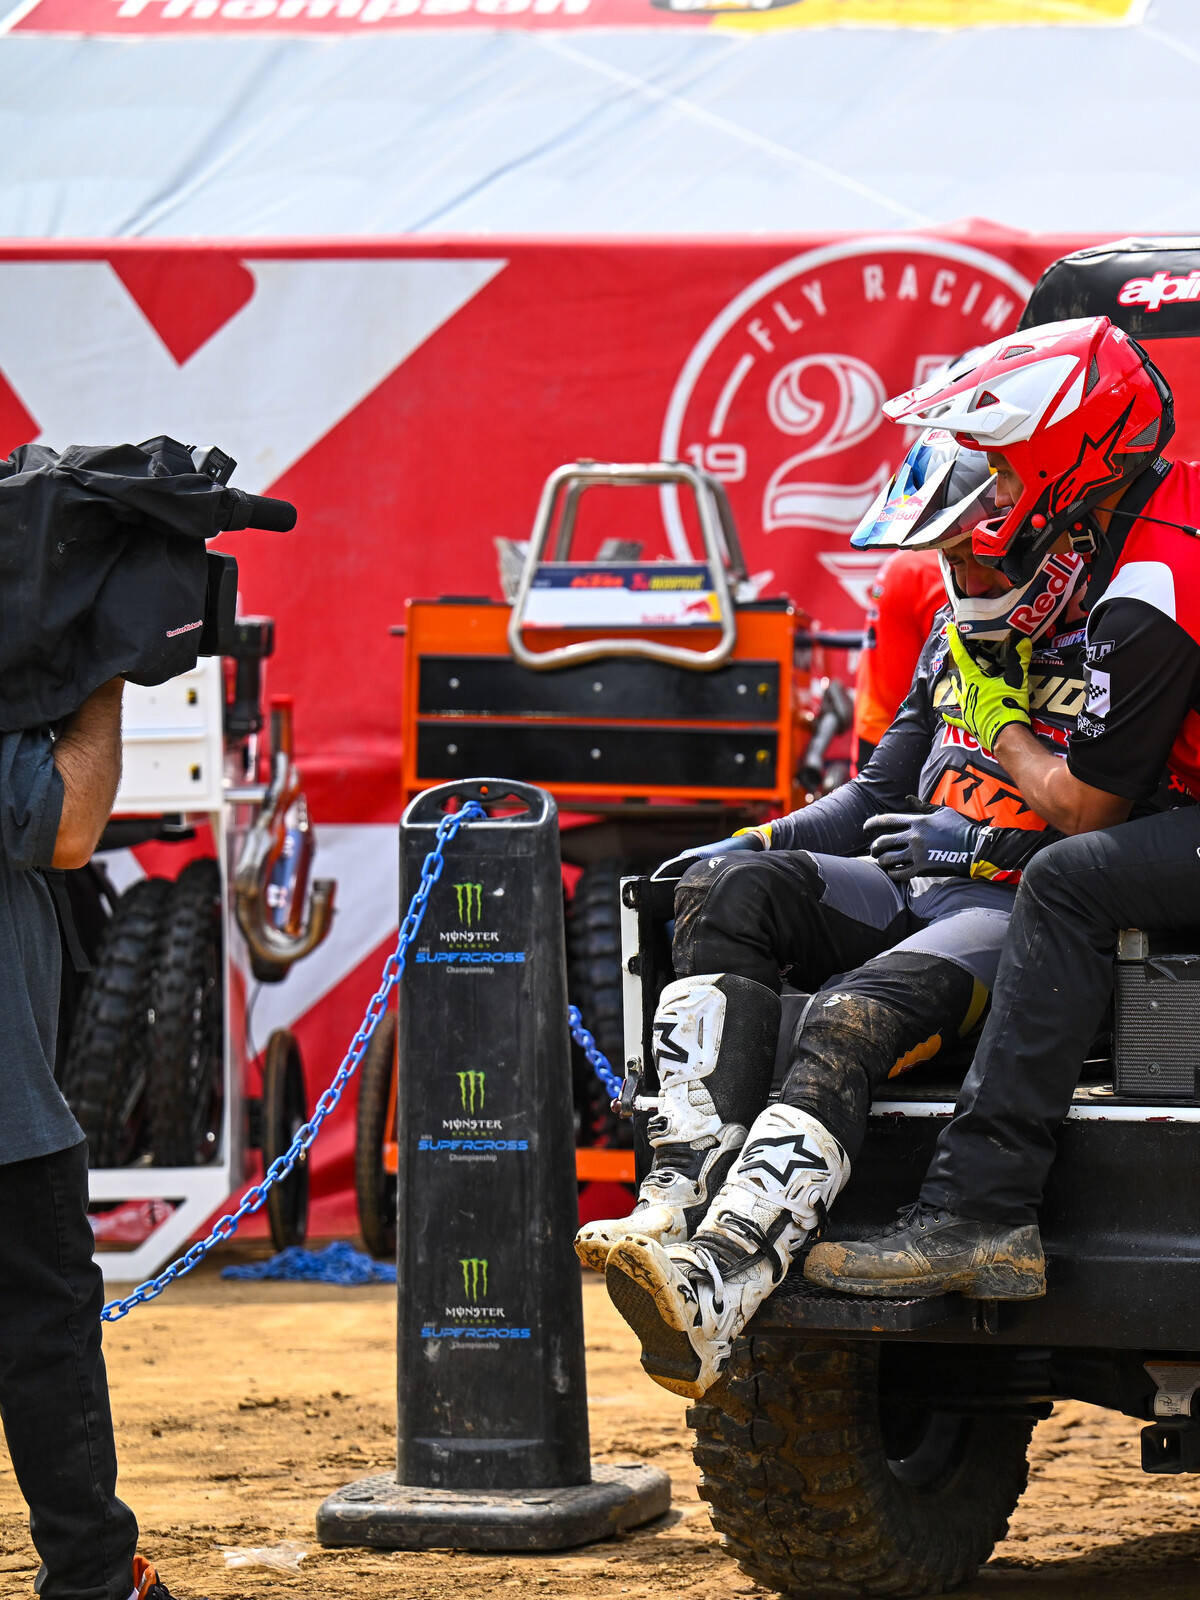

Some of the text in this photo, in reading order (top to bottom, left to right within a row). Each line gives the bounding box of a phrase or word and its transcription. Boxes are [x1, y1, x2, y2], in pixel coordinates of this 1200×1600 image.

[747, 264, 1015, 352] FLY RACIN
[927, 431, 953, 442] BEL
[685, 443, 748, 482] 19
[928, 849, 969, 864] THOR
[415, 952, 526, 963] SUPERCROSS
[446, 965, 495, 974] Championship
[418, 1140, 528, 1151] SUPERCROSS
[421, 1327, 531, 1338] SUPERCROSS
